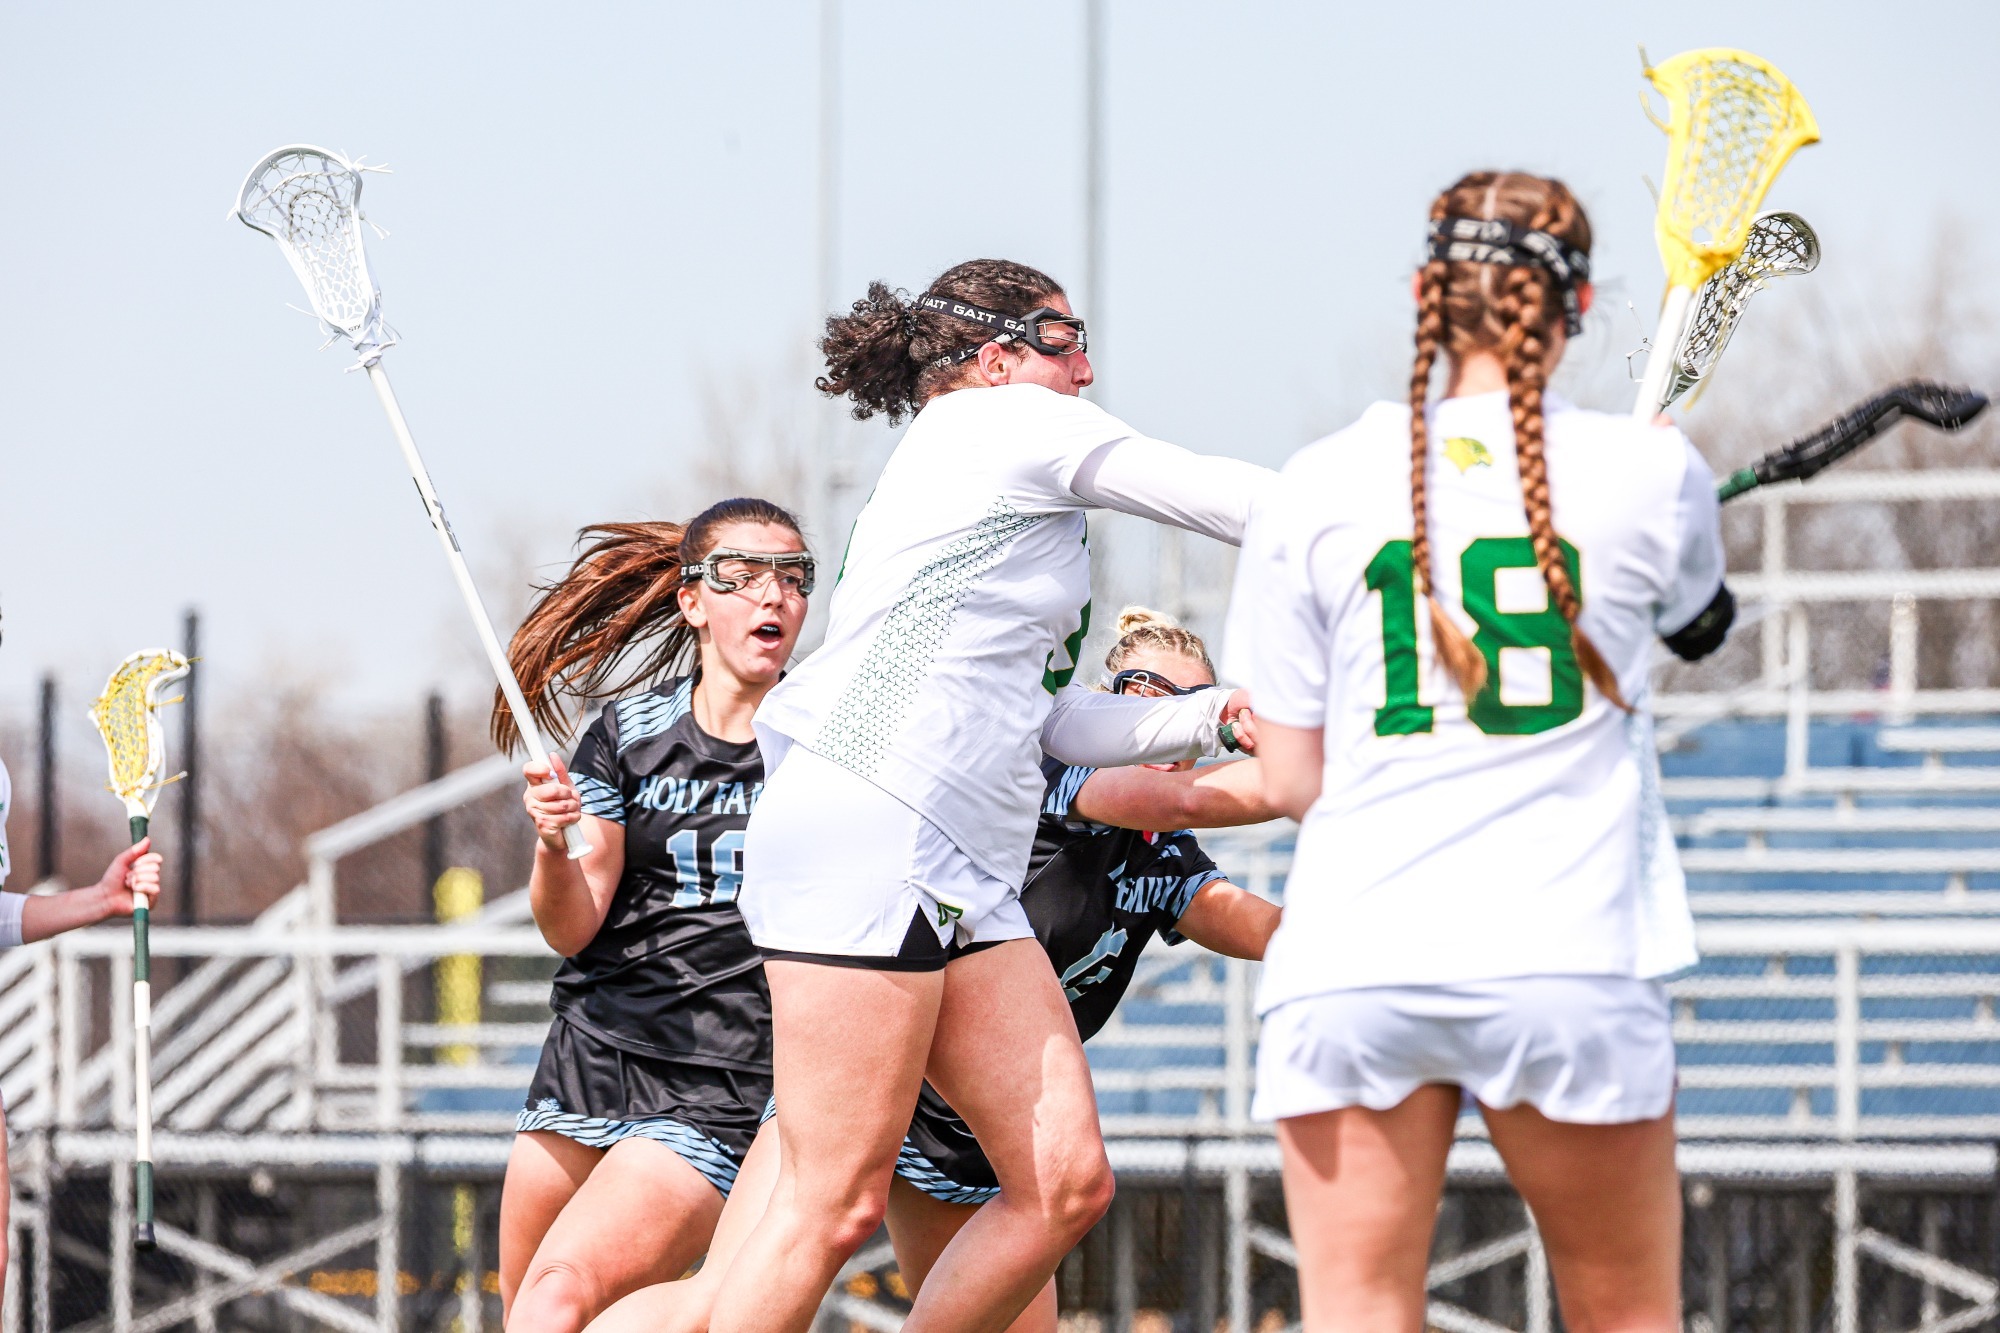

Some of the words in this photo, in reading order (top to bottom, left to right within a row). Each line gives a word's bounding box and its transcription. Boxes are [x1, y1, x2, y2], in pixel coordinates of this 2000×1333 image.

[953, 304, 997, 323] GAIT
[1364, 537, 1583, 735] 18
[633, 774, 710, 814] HOLY
